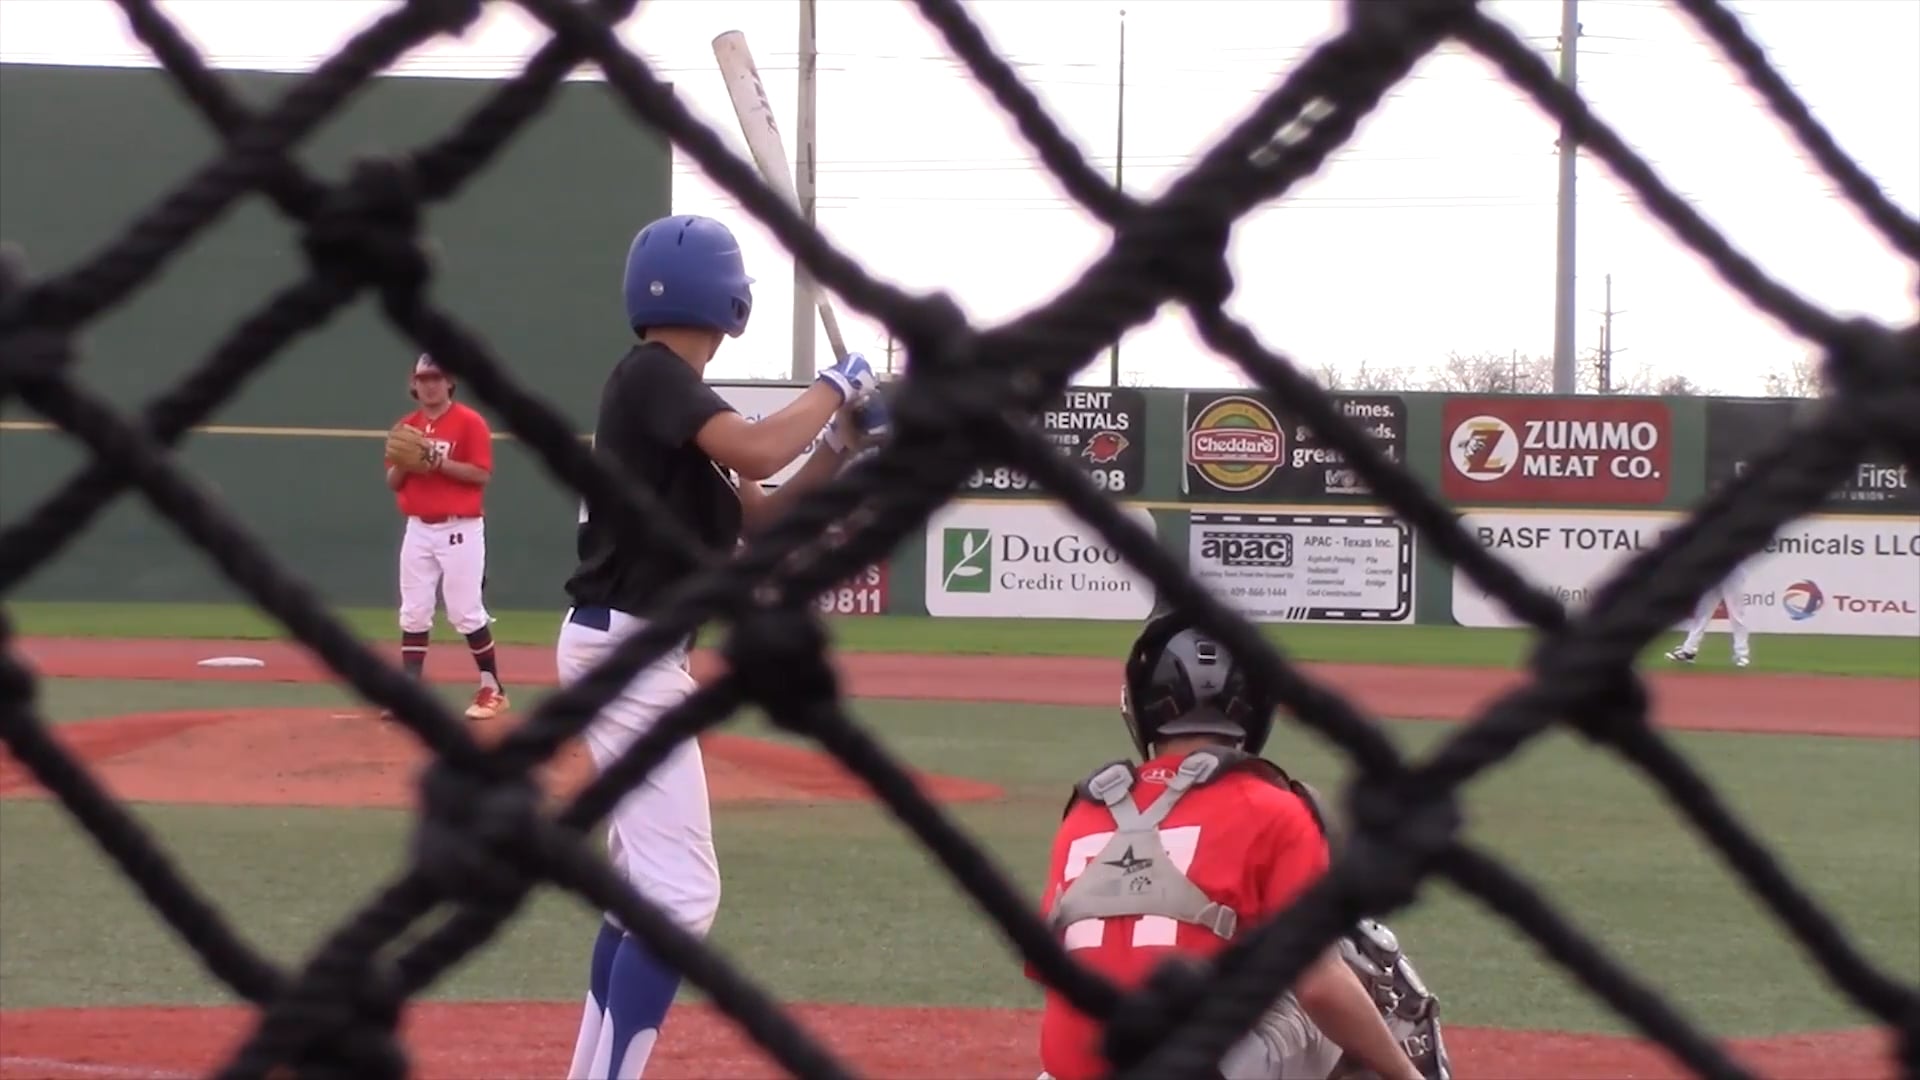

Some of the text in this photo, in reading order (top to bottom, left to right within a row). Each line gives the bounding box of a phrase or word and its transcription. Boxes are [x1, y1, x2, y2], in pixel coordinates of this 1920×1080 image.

[1065, 392, 1112, 409] TENT
[1343, 400, 1395, 417] times.
[1044, 412, 1129, 430] RENTALS
[1523, 421, 1658, 451] ZUMMO
[1292, 447, 1345, 468] grea
[1523, 455, 1660, 479] MEAT CO.
[1857, 463, 1907, 488] First
[1001, 534, 1122, 564] DuGoo
[1304, 536, 1333, 547] APAC
[1343, 537, 1372, 548] Texas
[1375, 538, 1394, 548] Inc.
[1478, 527, 1551, 549] BASF
[1560, 528, 1650, 551] TOTAL
[1201, 539, 1284, 565] apac
[1000, 572, 1131, 592] Credit Union
[1744, 592, 1917, 614] and TOTAL
